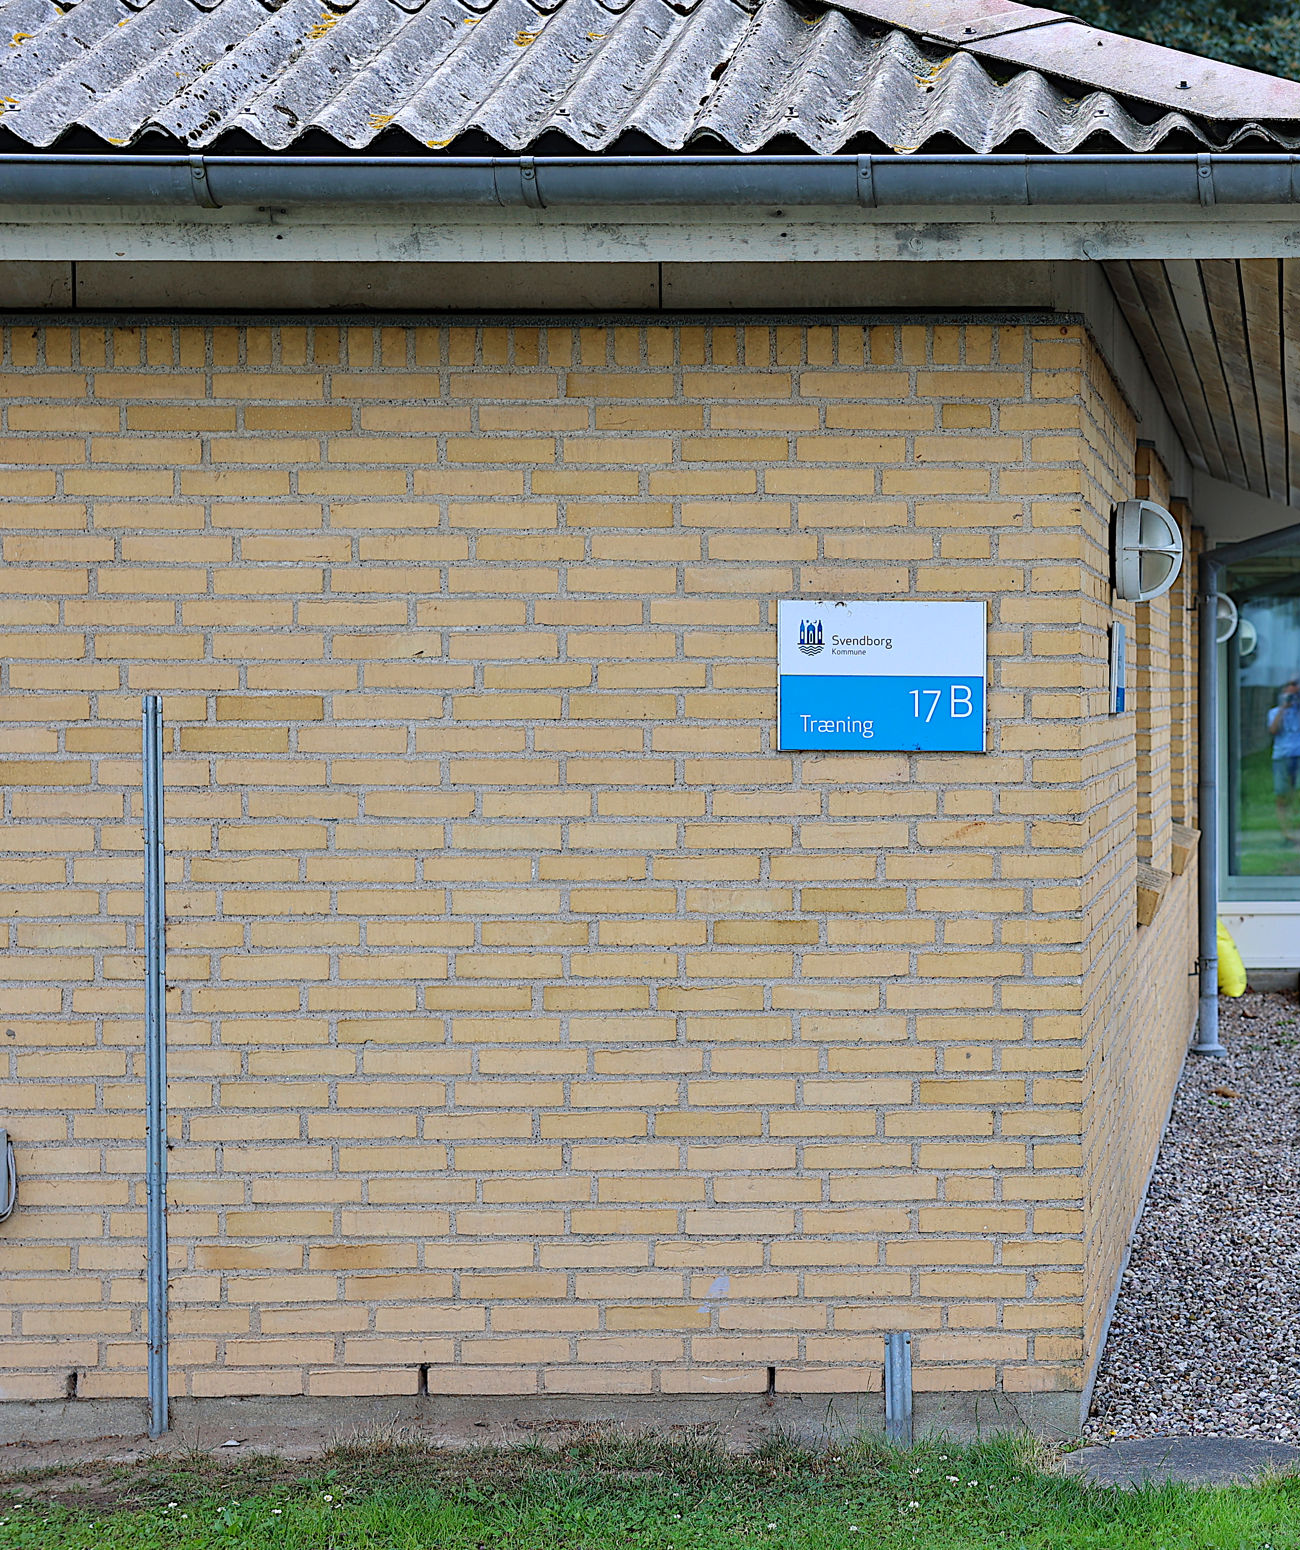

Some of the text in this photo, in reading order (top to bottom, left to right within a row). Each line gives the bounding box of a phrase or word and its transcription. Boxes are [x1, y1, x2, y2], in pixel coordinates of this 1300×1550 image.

[831, 634, 893, 650] Svendborg
[831, 648, 867, 656] Kommune
[799, 714, 874, 740] Træning
